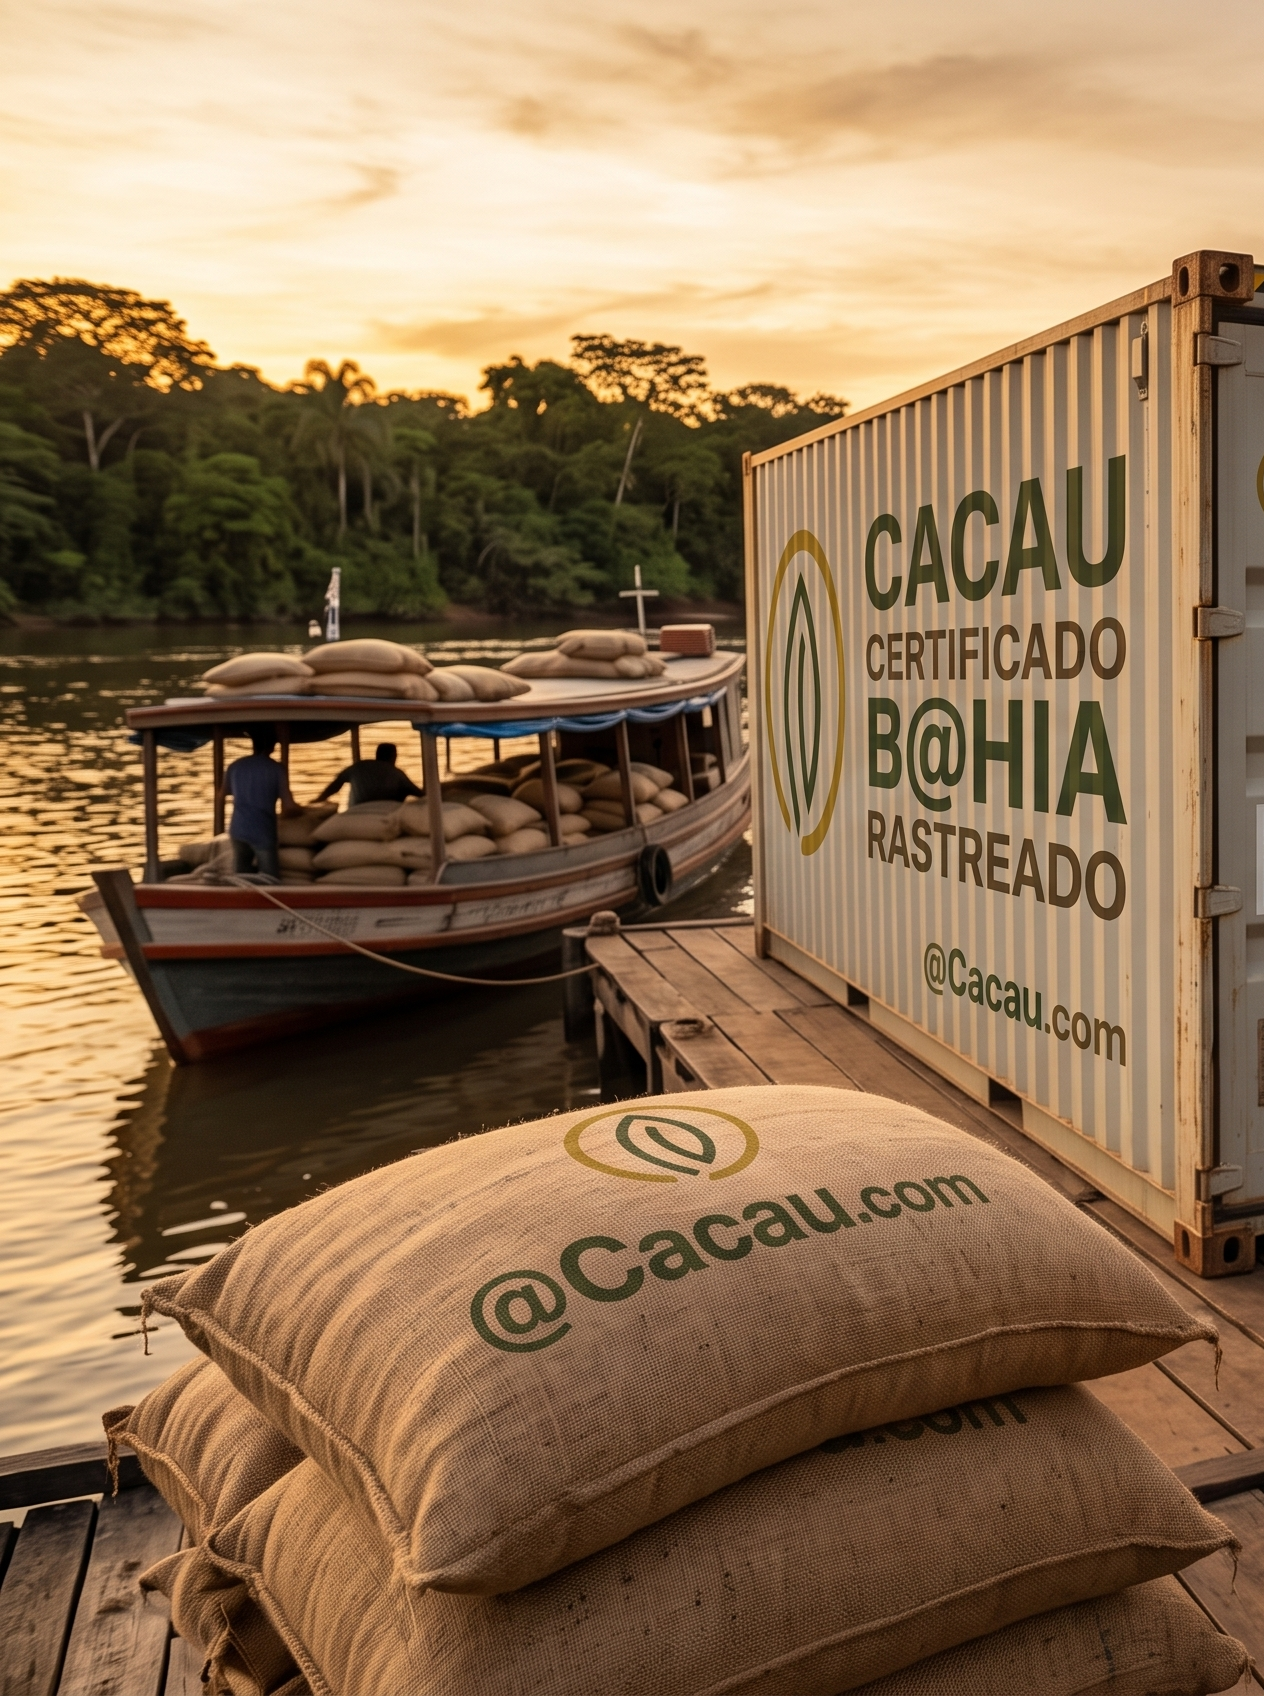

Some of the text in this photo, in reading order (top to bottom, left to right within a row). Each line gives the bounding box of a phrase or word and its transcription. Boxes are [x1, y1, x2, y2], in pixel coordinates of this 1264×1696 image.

[865, 454, 1126, 611] CACAU
[865, 616, 1127, 681] CERTIFICADO
[867, 697, 1128, 826] B@HIA
[867, 809, 1127, 921] RASTREADO
[923, 942, 1127, 1067] @Cacau.com
[470, 1174, 990, 1353] @Cacau.com
[820, 1397, 1028, 1454] .com
